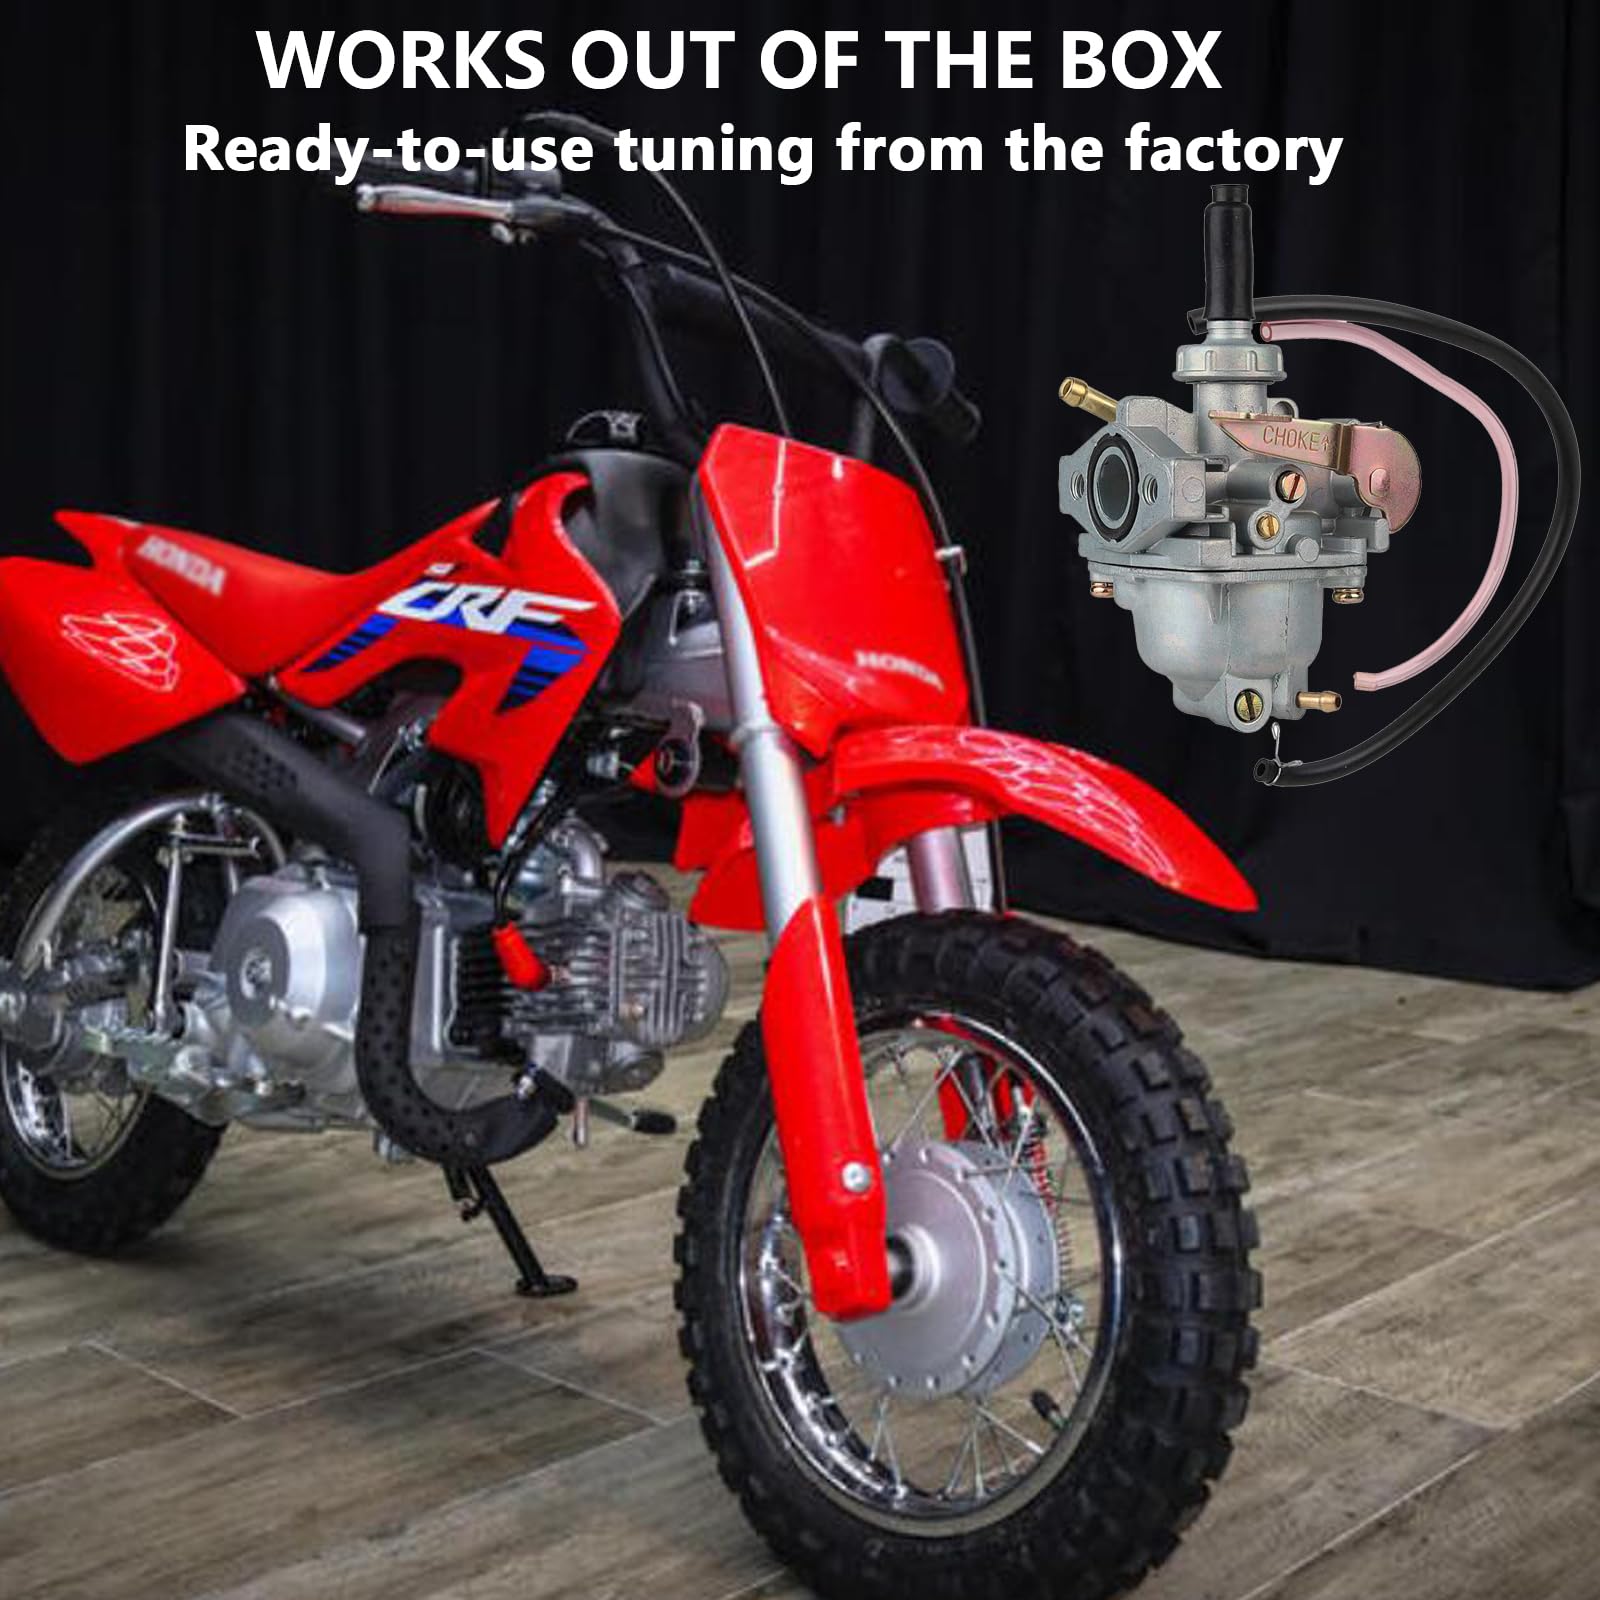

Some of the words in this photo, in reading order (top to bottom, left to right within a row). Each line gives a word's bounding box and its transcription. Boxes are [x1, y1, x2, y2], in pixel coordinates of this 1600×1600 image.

[1263, 425, 1320, 451] CHOKE
[138, 535, 225, 596] HONDA
[376, 576, 597, 634] CRF
[855, 650, 944, 693] HONDA
